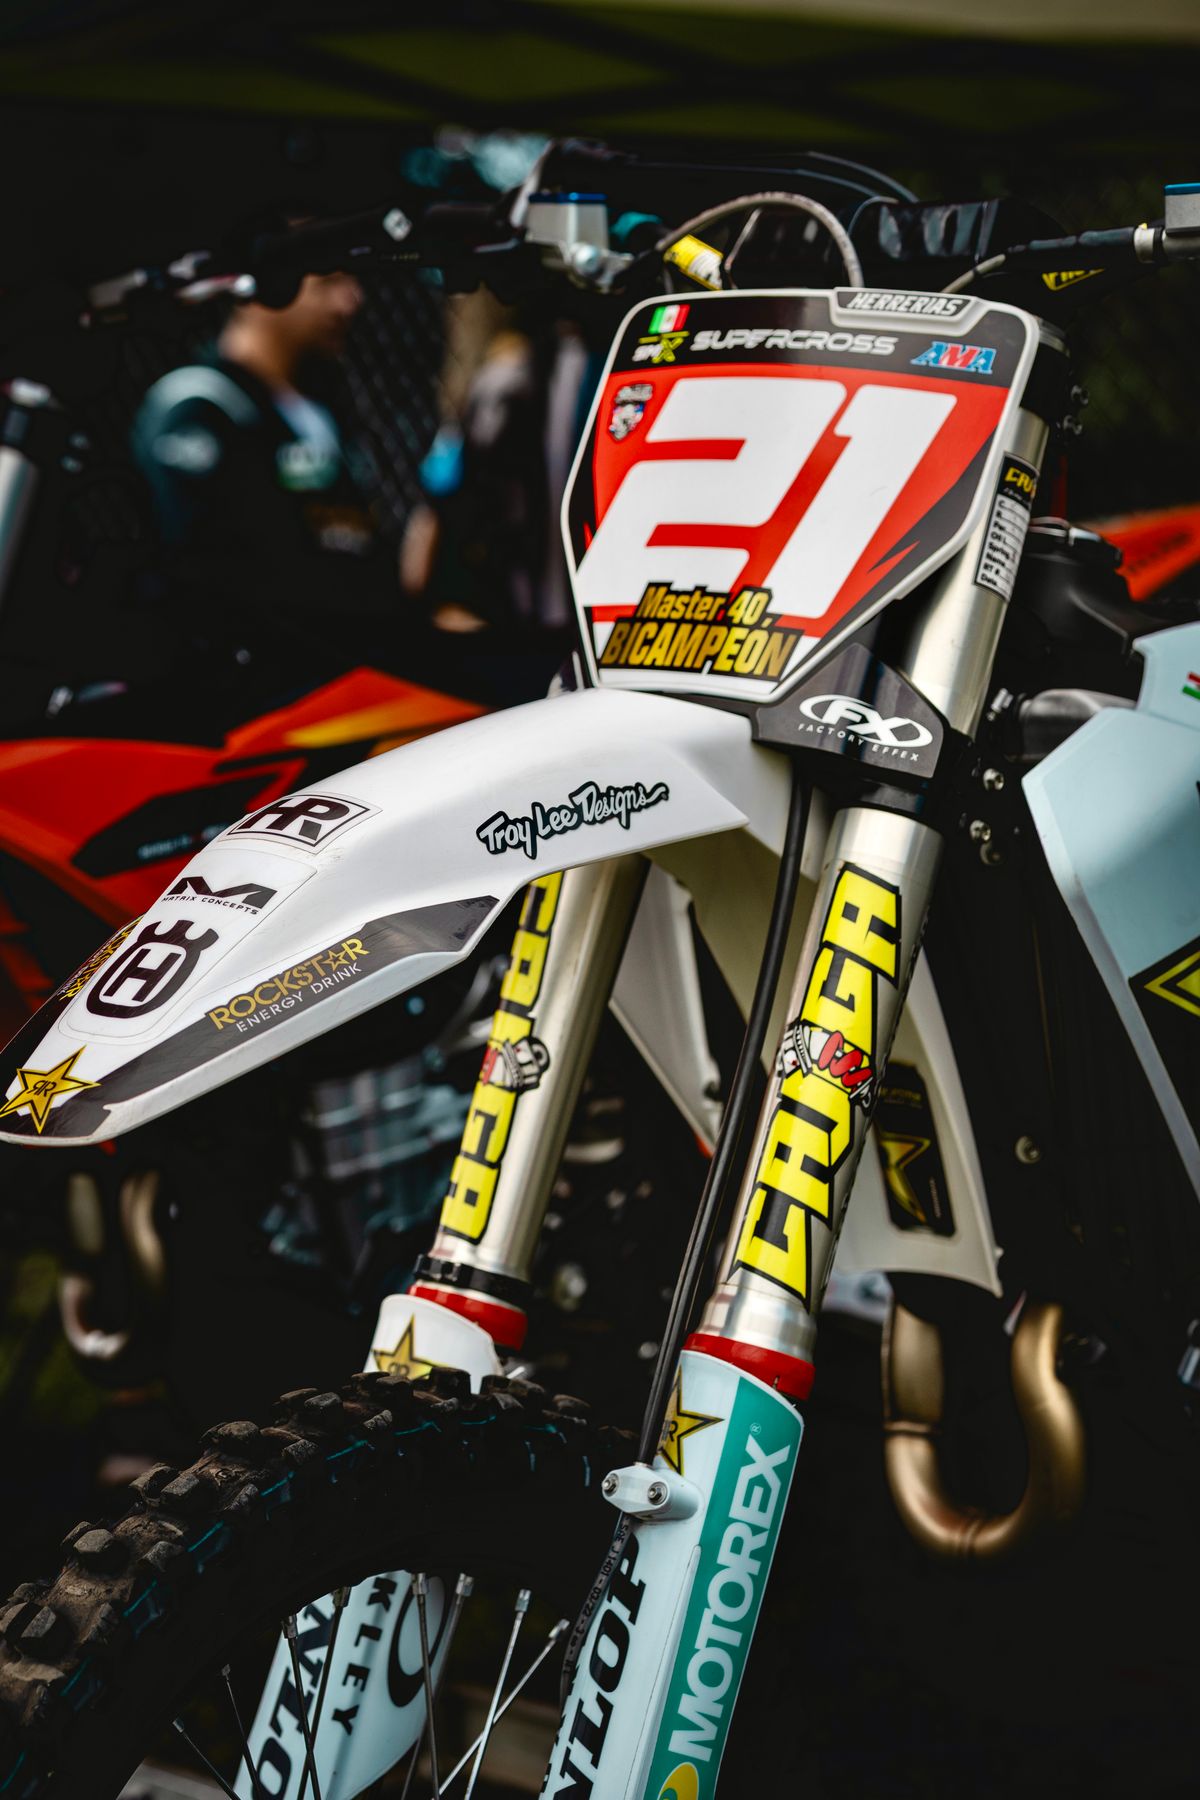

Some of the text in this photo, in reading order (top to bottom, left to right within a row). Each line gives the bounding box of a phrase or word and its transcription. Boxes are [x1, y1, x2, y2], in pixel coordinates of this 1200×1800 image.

[847, 292, 964, 316] HERRERIAS
[690, 328, 899, 355] SUPERCROSS
[910, 341, 997, 374] AMA
[575, 376, 958, 619] 21
[635, 585, 726, 622] Master
[797, 722, 920, 762] FACTORY EFFEX
[478, 783, 667, 858] Troy Lee Designs
[160, 895, 260, 916] MATRIX CONCEPTS
[235, 961, 363, 1033] ENERGY DRINK
